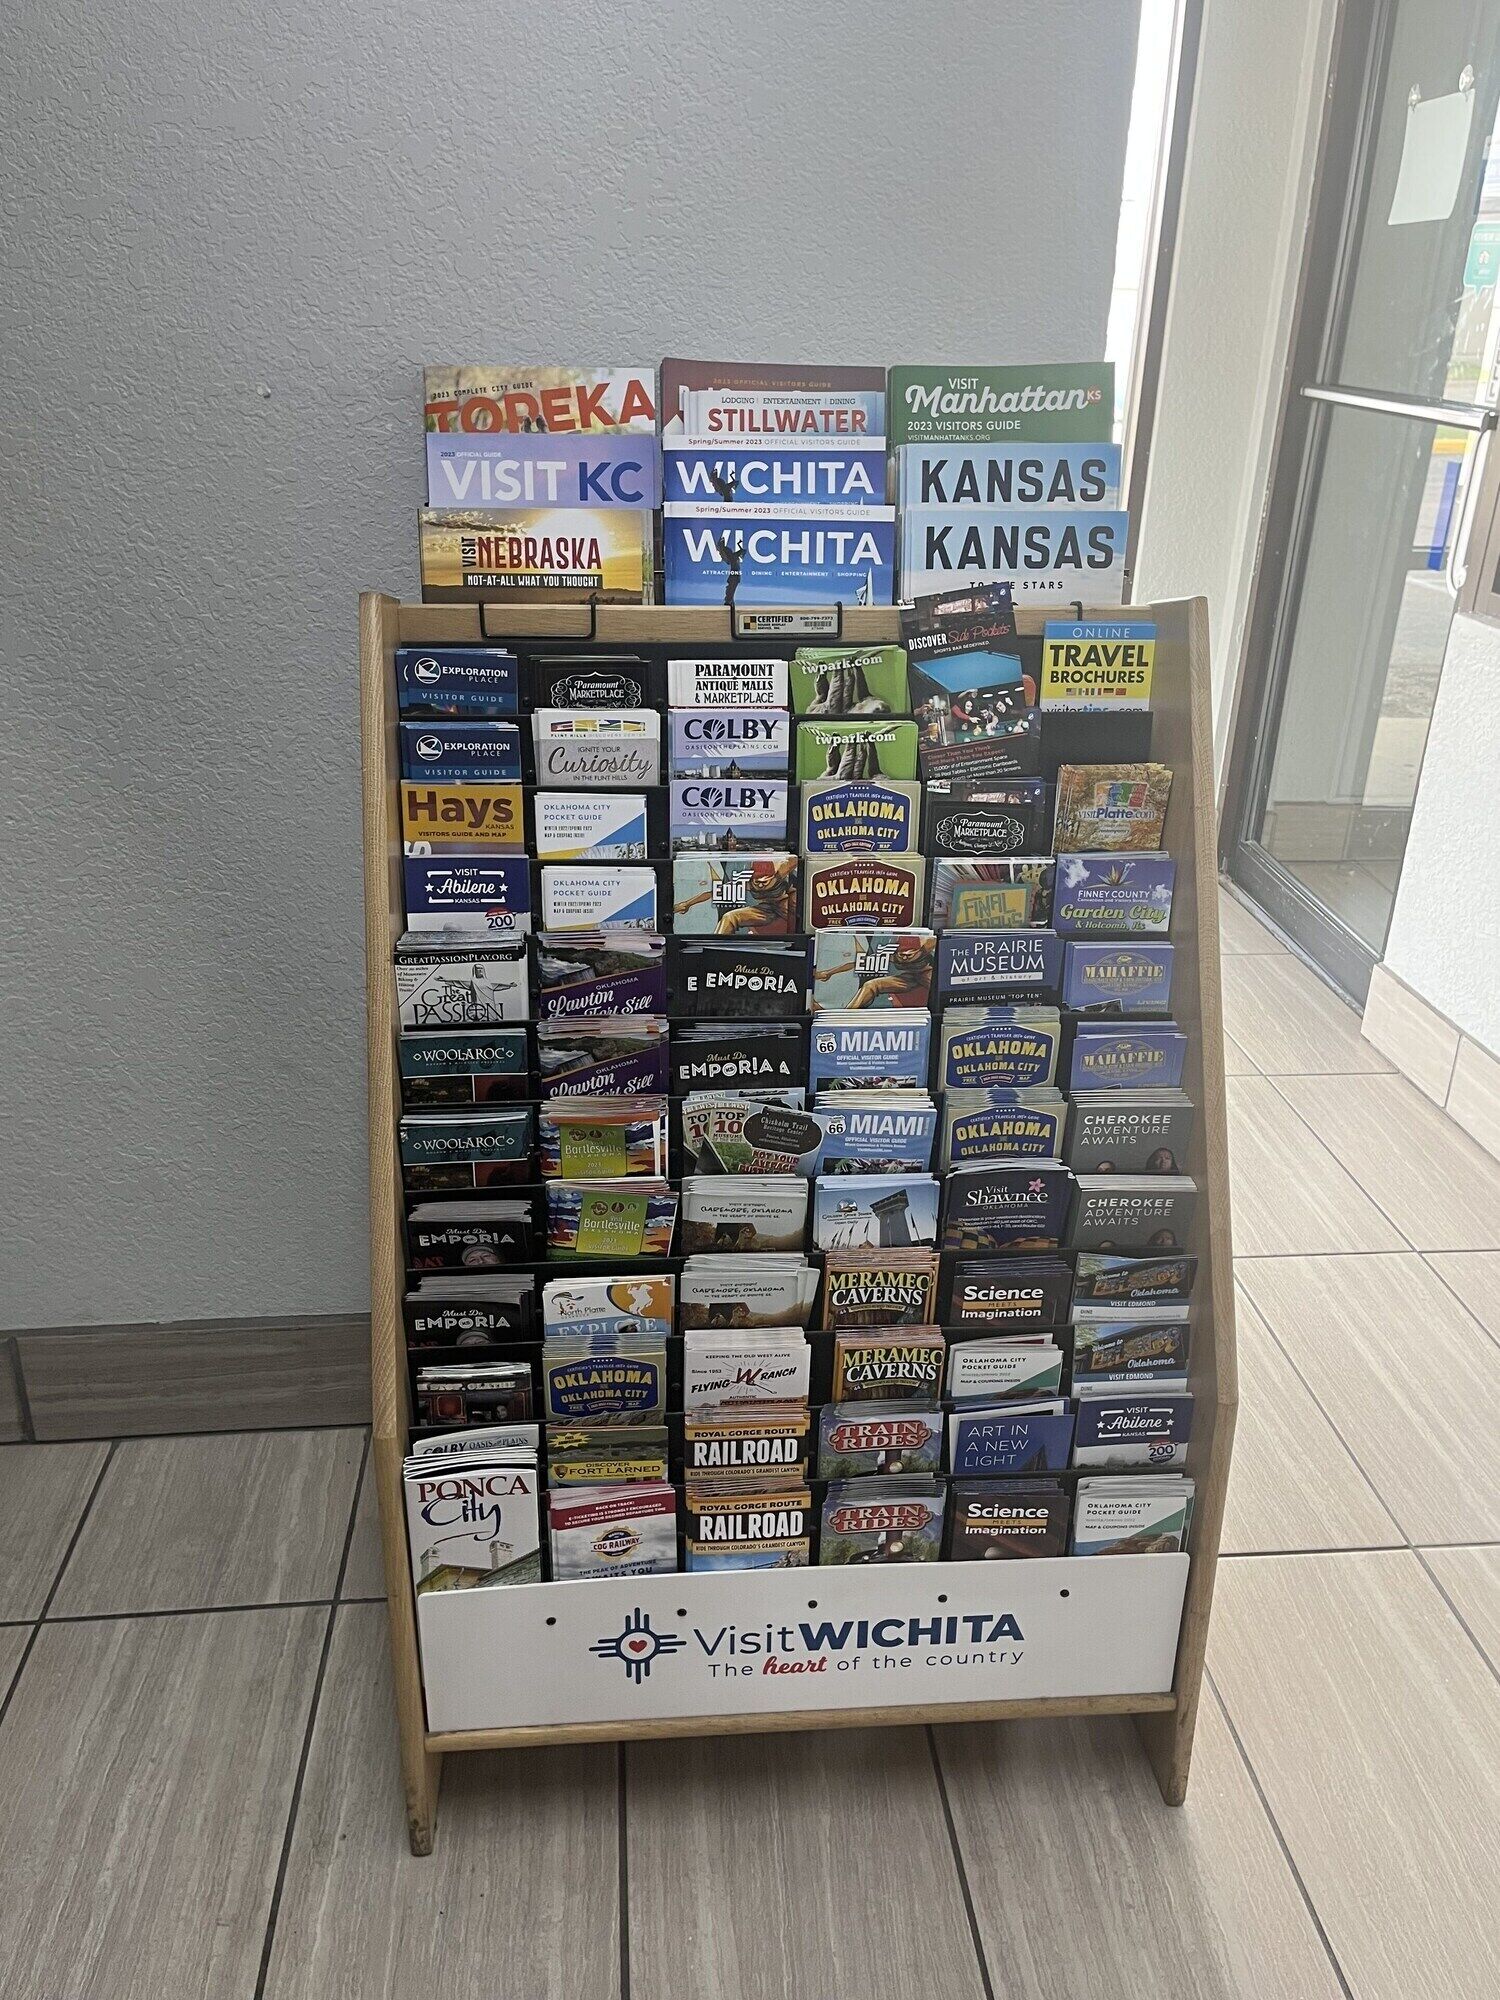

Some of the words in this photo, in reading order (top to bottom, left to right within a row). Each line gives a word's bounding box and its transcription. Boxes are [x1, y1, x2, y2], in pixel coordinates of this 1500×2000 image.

[433, 391, 453, 399] 2023
[454, 388, 489, 397] COMPLETE
[491, 385, 509, 393] CITY
[511, 382, 534, 391] GUIDE
[948, 378, 978, 389] VISIT
[905, 385, 1090, 419] Manhattan
[708, 408, 867, 434] STILLWATER
[907, 421, 933, 432] 2023
[935, 421, 979, 432] VISITORS
[982, 421, 1021, 432] GUIDE
[907, 434, 991, 442] VISITMANHATTANKS.ORG
[440, 459, 566, 501] VISIT
[579, 461, 645, 503] KC
[676, 461, 875, 495] WICHITA
[920, 459, 1107, 504] KANSAS
[695, 505, 749, 515] Spring/Summer
[773, 507, 805, 515] OFFICIAL
[808, 508, 836, 516] VISITORS
[461, 536, 477, 568] VISIT
[478, 536, 602, 570] NEBRASKA
[682, 528, 883, 566] WICHITA
[925, 525, 1115, 570] KANSAS
[468, 575, 516, 586] NOT-AT-ALL
[518, 576, 540, 586] WHAT
[543, 576, 560, 587] YOU
[562, 576, 599, 588] THOUGHT
[1072, 627, 1131, 639] ONLINE
[1049, 645, 1149, 668] TRAVEL
[442, 666, 509, 679] EXPLORATION
[695, 664, 775, 677] PARAMOUNT
[802, 655, 883, 675] twpark.com
[1049, 670, 1145, 684] BROCHURES
[695, 681, 739, 692] ANTIQUE
[742, 681, 773, 691] MALLS
[684, 718, 779, 740] COLBY
[444, 742, 511, 753] EXPLORATION
[815, 731, 896, 748] twpark.com
[549, 746, 654, 781] Curiosity
[407, 790, 514, 829] Hays
[812, 801, 904, 822] OKLAHOMA
[1076, 807, 1155, 821] visitPlatte.com
[817, 826, 875, 840] OKLAHOMA
[877, 826, 900, 839] CITY
[953, 827, 1007, 839] MARKETPLACE
[454, 869, 479, 877] VISIT
[436, 878, 496, 895] Abilene
[712, 880, 747, 904] Enid
[815, 878, 910, 899] OKLAHOMA
[1077, 890, 1110, 899] FINNEY
[1111, 890, 1150, 899] COUNTY
[821, 902, 878, 916] OKLAHOMA
[881, 902, 905, 915] CITY
[950, 949, 969, 957] THE
[974, 939, 1043, 955] PRAIRIE
[950, 955, 1045, 974] MUSEUM
[1085, 966, 1163, 978] MAHAFFIE
[421, 988, 472, 1008] Great
[442, 985, 466, 996] The
[980, 994, 1007, 1002] MUSEUM
[548, 990, 614, 1019] Lawton
[819, 1041, 834, 1053] 66
[841, 1031, 914, 1052] MIAMI
[951, 1039, 1047, 1060] OKLAHOMA
[422, 1046, 506, 1062] WOOLAROC
[956, 1061, 1014, 1075] OKLAHOMA
[1017, 1062, 1041, 1073] CITY
[828, 1123, 844, 1135] 66
[850, 1114, 924, 1136] MIAMI
[1083, 1114, 1173, 1125] CHEROKEE
[955, 1120, 1051, 1142] OKLAHOMA
[1081, 1125, 1170, 1136] ADVENTURE
[422, 1135, 506, 1151] WOOLAROC
[1080, 1135, 1138, 1146] AWAITS
[960, 1142, 1019, 1156] OKLAHOMA
[1021, 1142, 1046, 1154] CITY
[964, 1190, 1049, 1208] Shawnee
[1086, 1197, 1175, 1209] CHEROKEE
[1084, 1208, 1172, 1218] ADVENTURE
[1082, 1217, 1140, 1227] AWAITS
[828, 1271, 930, 1292] MERAMEC
[832, 1288, 924, 1306] CAVERNS
[963, 1285, 1044, 1301] Science
[961, 1308, 1042, 1320] Imagination
[843, 1347, 944, 1369] MERAMEC
[552, 1369, 653, 1390] OKLAHOMA
[846, 1362, 938, 1383] CAVERNS
[560, 1390, 623, 1404] OKLAHOMA
[624, 1390, 648, 1399] CITY
[839, 1421, 920, 1439] TRAIN
[966, 1425, 1002, 1438] ART
[1010, 1424, 1029, 1436] IN
[1106, 1416, 1163, 1431] Abilene
[840, 1435, 920, 1449] RIDES
[965, 1440, 979, 1452] A
[984, 1439, 1030, 1451] NEW
[693, 1438, 798, 1467] RAILROAD
[1148, 1445, 1175, 1457] 200
[964, 1454, 1016, 1467] LIGHT
[569, 1467, 604, 1475] FORT
[606, 1465, 661, 1475] LARNED
[690, 1470, 701, 1478] RIDE
[726, 1467, 756, 1476] COLORADO'S
[780, 1465, 801, 1473] CANYON
[416, 1475, 532, 1503] PONCA
[421, 1489, 502, 1542] City
[839, 1505, 922, 1521] TRAIN
[966, 1503, 1050, 1519] Science
[699, 1510, 804, 1541] RAILROAD
[840, 1517, 921, 1531] RIDES
[964, 1526, 1048, 1537] Imagination
[593, 1543, 609, 1552] COG
[609, 1537, 642, 1551] RAILWAY
[580, 1569, 594, 1577] THE
[595, 1567, 612, 1575] PEAK
[619, 1561, 658, 1572] ADVENTURE
[708, 1663, 754, 1679] The
[762, 1656, 828, 1675] heart
[836, 1655, 861, 1671] of
[872, 1654, 912, 1670] the
[924, 1650, 1026, 1668] country
